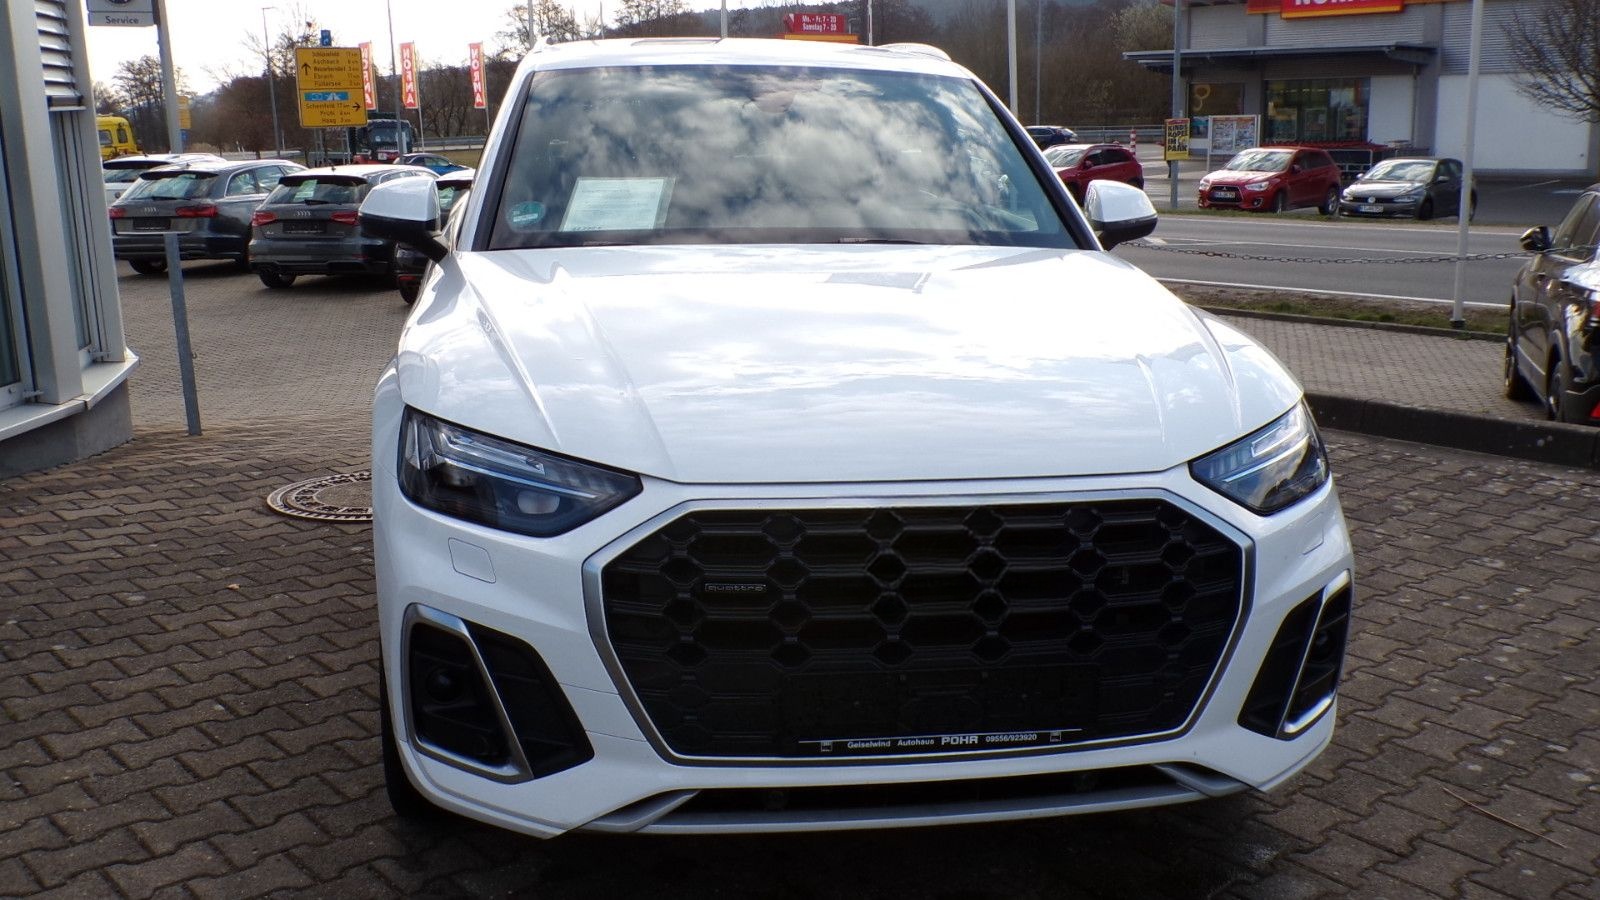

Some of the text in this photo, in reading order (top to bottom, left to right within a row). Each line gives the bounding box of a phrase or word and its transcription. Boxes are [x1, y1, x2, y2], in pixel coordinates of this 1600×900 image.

[105, 15, 140, 24] Service
[803, 23, 822, 32] Samstag
[707, 584, 765, 592] quattro
[847, 740, 890, 749] Geiselwind
[897, 737, 935, 747] Autohaus
